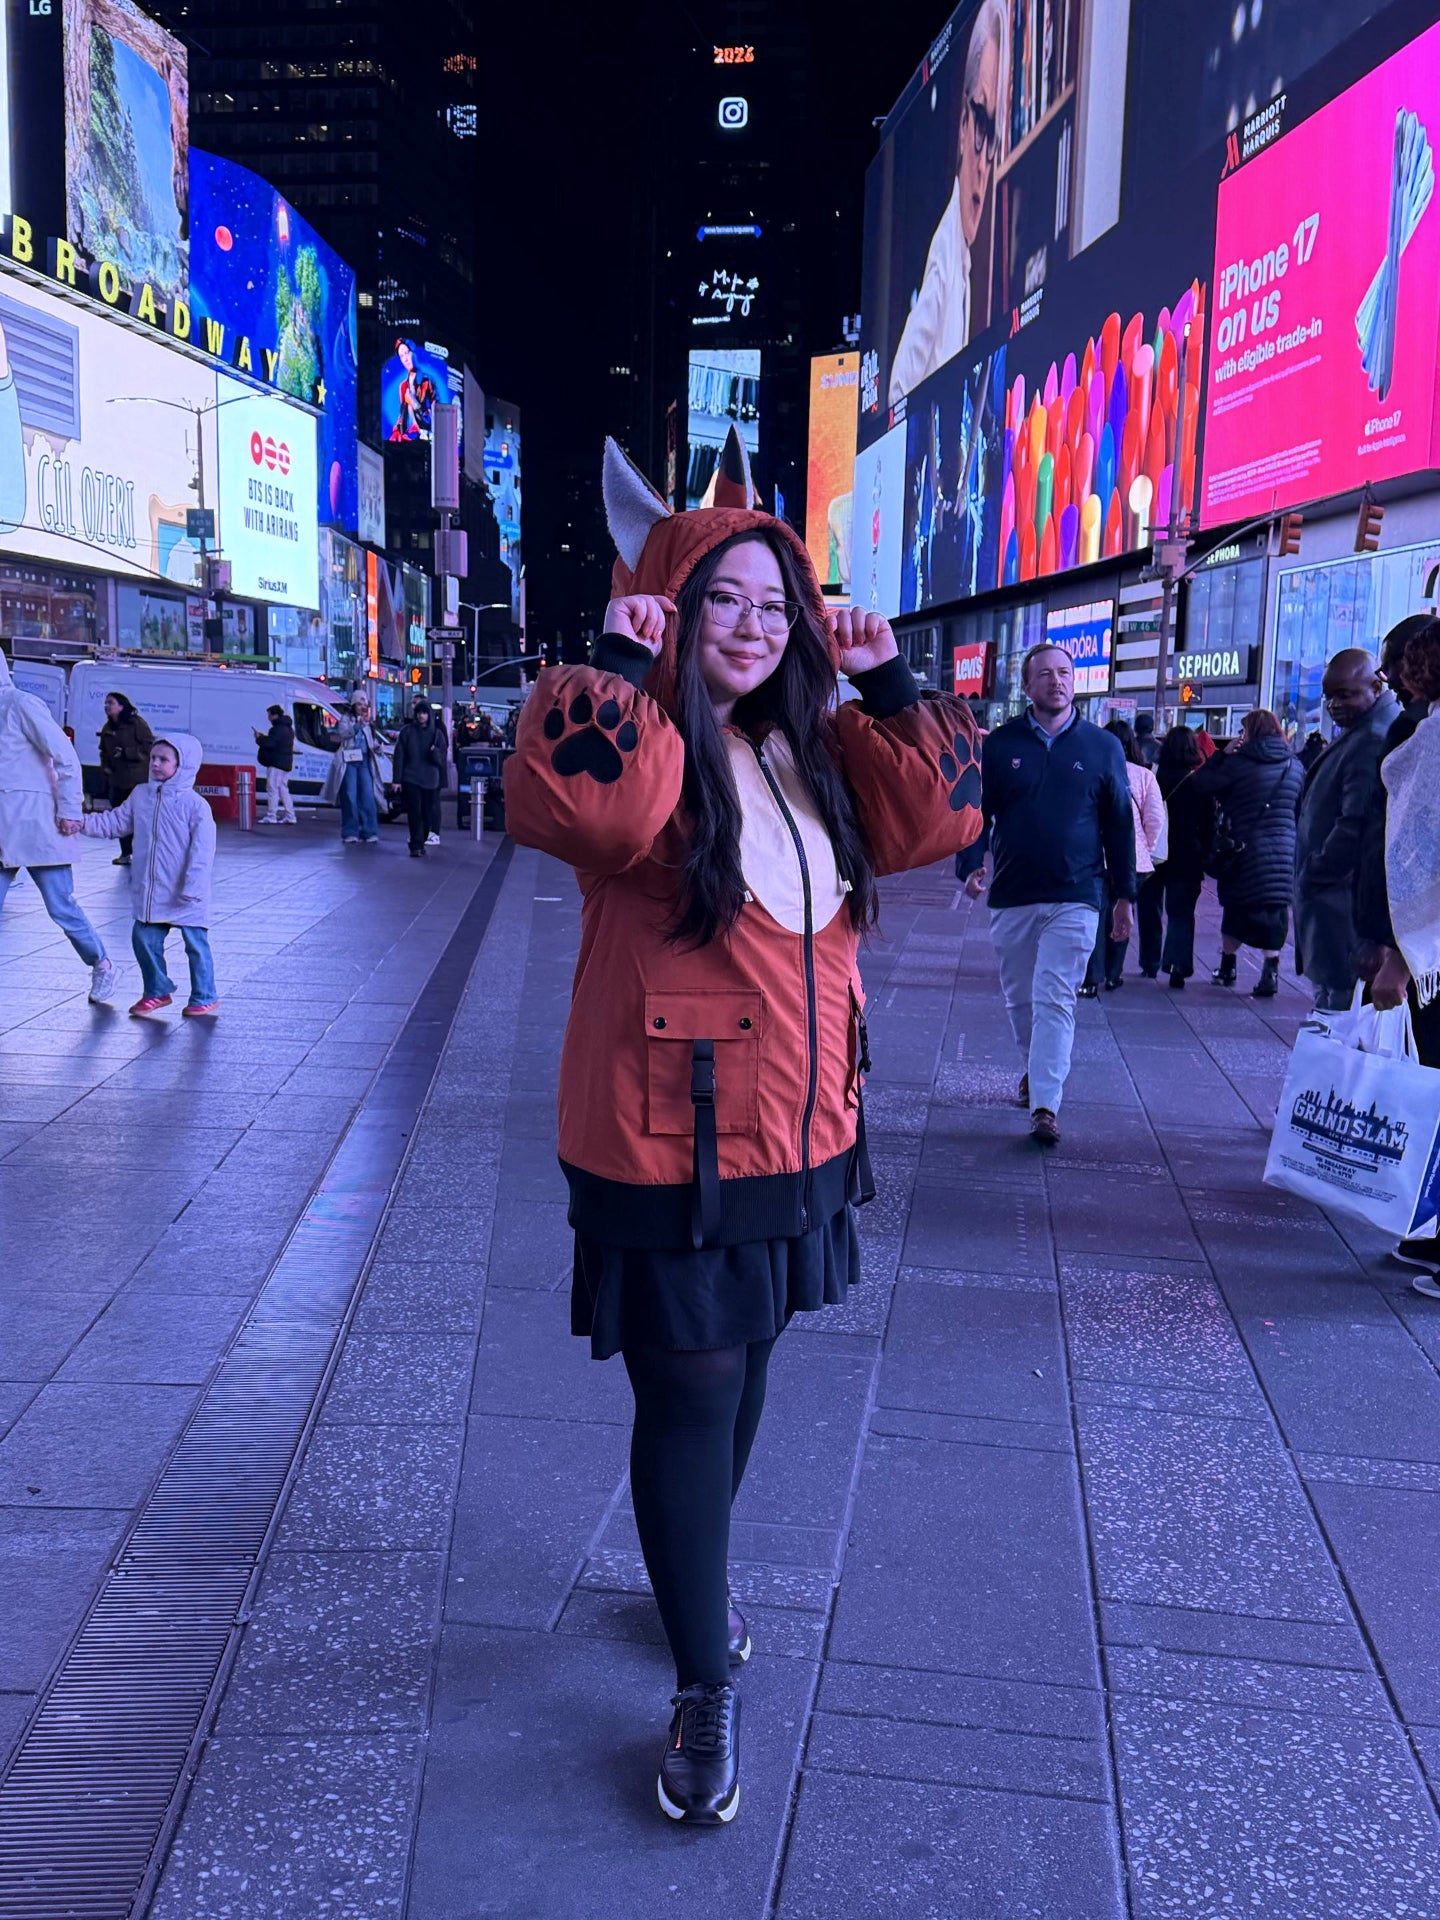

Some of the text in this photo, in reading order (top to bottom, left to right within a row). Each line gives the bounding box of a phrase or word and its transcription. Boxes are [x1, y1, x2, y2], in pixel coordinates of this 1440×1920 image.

[29, 0, 51, 15] LG
[713, 46, 755, 64] 2026
[1243, 95, 1287, 138] MARRIOTT
[1242, 119, 1281, 158] MARQUIS
[1219, 212, 1320, 311] iPhone 17
[12, 214, 278, 382] BROADWAY
[1218, 289, 1282, 353] on us
[1214, 317, 1323, 384] with eligible trade-in
[38, 454, 77, 537] GIL
[248, 477, 295, 513] BTS IS BACK
[243, 507, 299, 542] WITH ARIRANG
[258, 576, 288, 595] SiriusXM
[1140, 622, 1150, 632] 46
[1178, 650, 1240, 679] SEPHORA
[1293, 1098, 1409, 1151] GRAND SLAM
